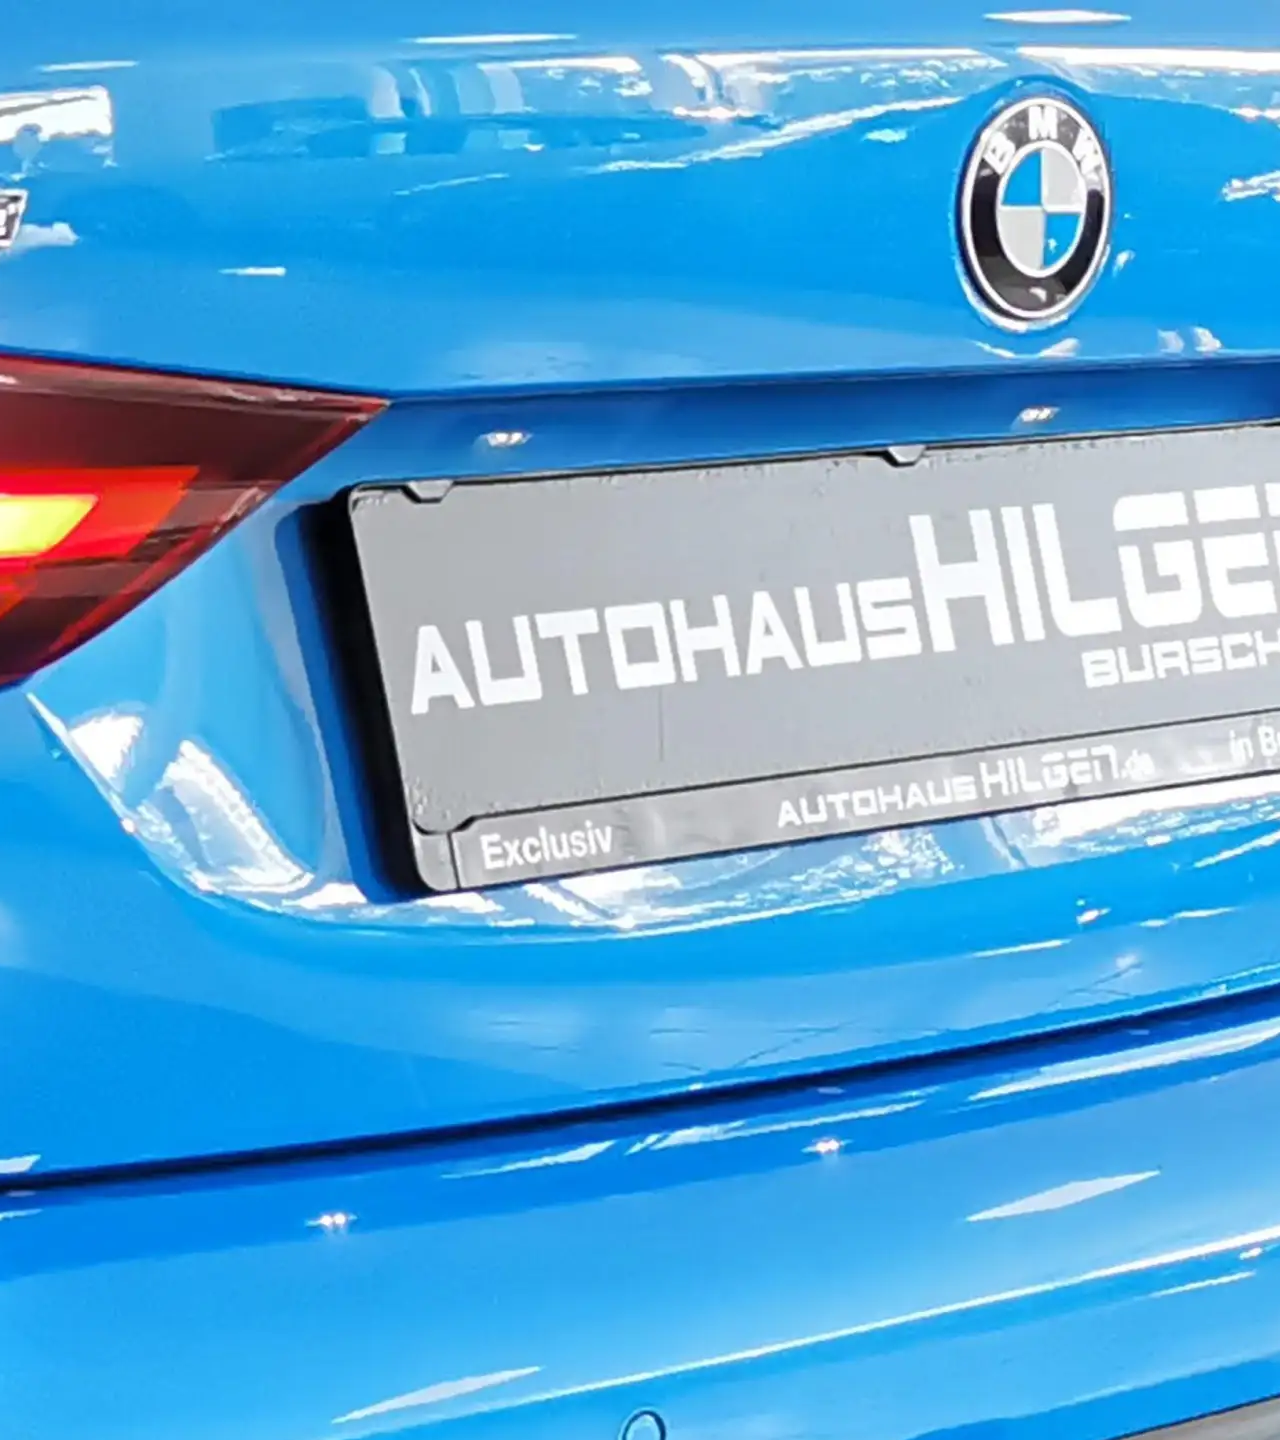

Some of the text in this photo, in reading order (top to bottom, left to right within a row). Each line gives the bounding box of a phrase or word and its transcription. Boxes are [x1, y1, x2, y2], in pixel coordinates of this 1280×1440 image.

[982, 105, 1103, 174] BMW
[480, 820, 612, 869] Exclusiv
[777, 776, 978, 827] AUTOHAUS
[1228, 730, 1254, 763] in
